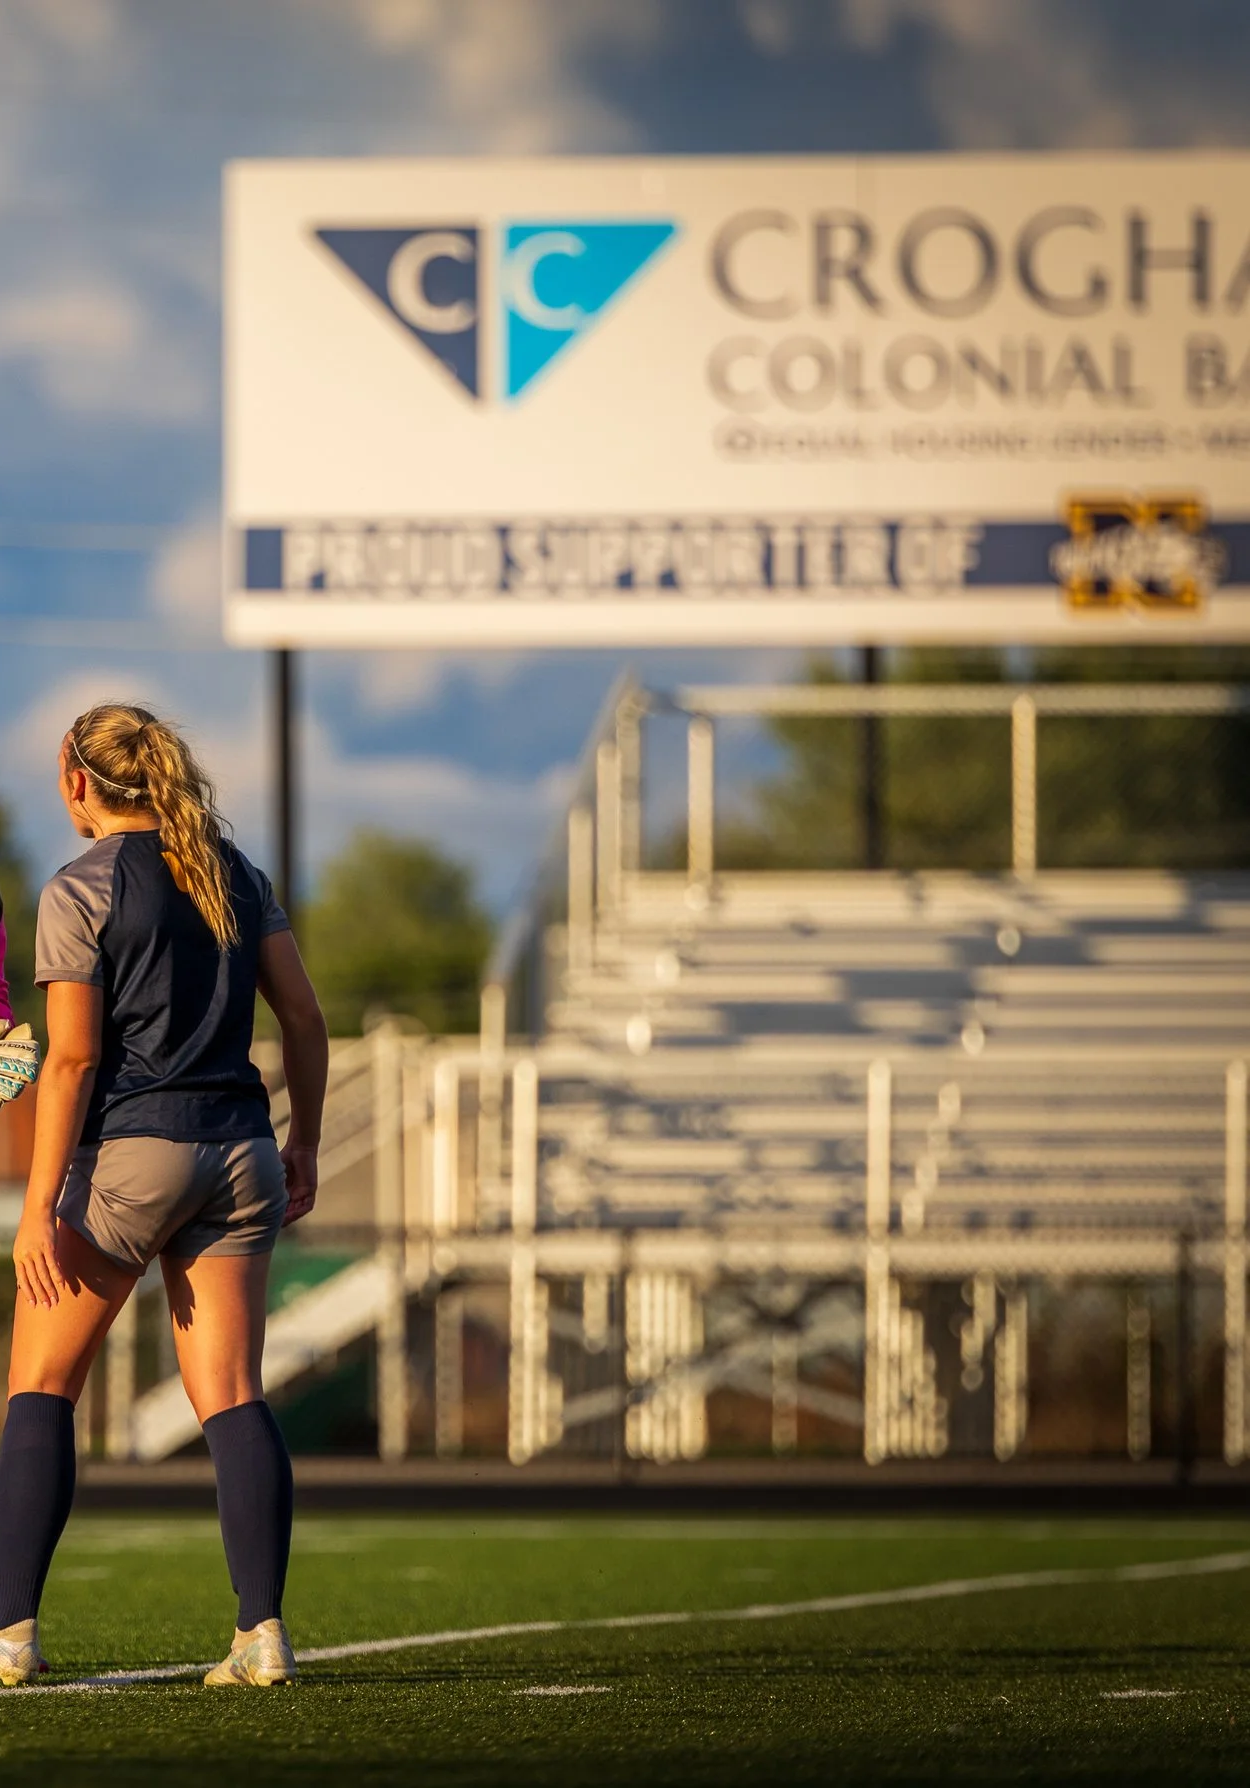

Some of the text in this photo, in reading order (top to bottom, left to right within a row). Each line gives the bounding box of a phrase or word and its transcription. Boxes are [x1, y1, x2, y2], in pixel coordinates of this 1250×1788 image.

[706, 332, 1155, 414] COLONIAL
[284, 514, 983, 600] PROUD SUPPORTER OF
